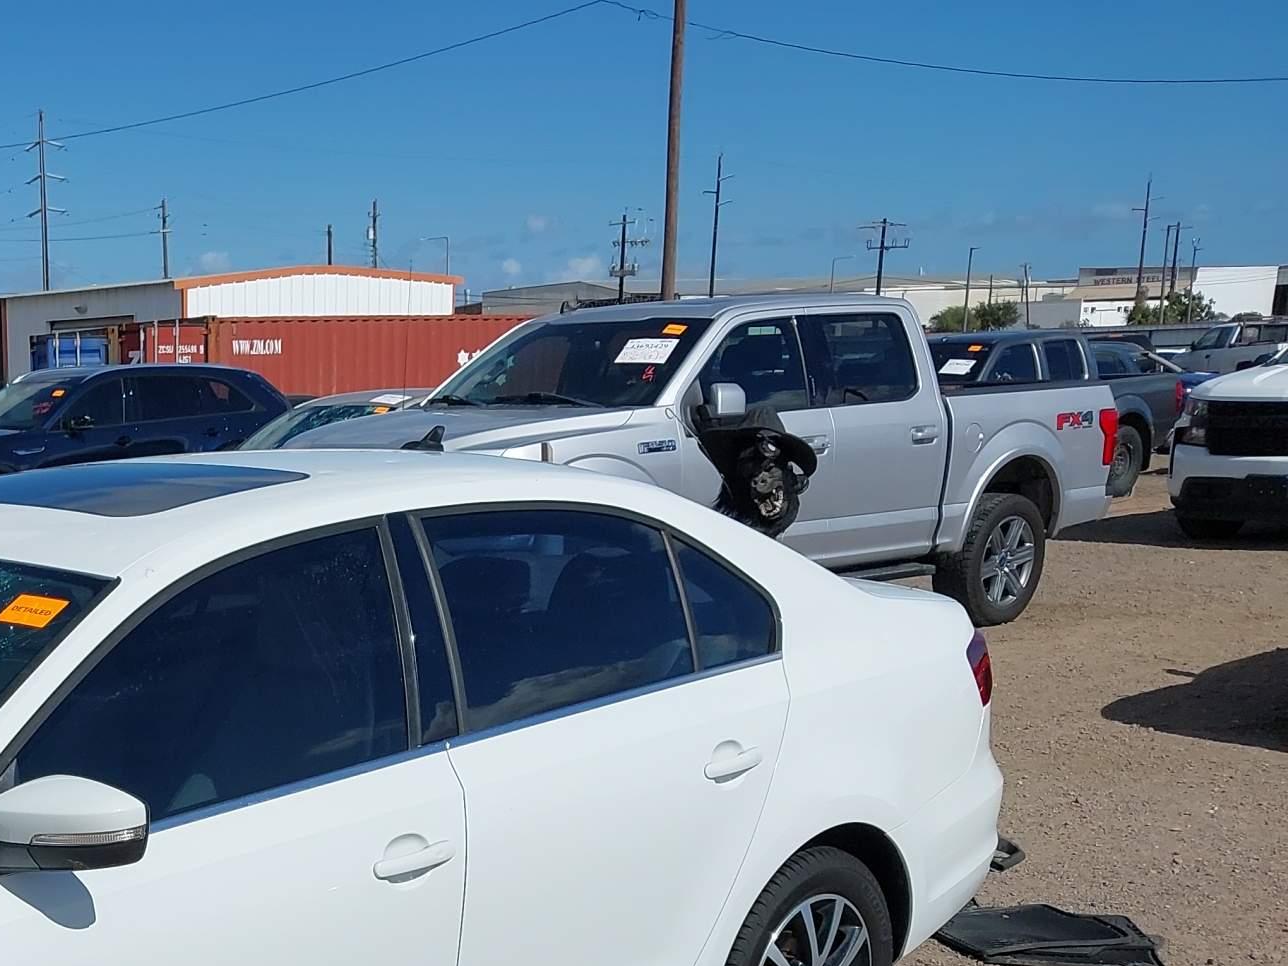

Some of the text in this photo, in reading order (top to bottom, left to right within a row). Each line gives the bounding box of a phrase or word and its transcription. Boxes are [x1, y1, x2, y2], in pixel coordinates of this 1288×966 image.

[1094, 276, 1133, 286] WESTERN
[1056, 410, 1094, 431] FX4
[12, 604, 52, 616] DETAILED
